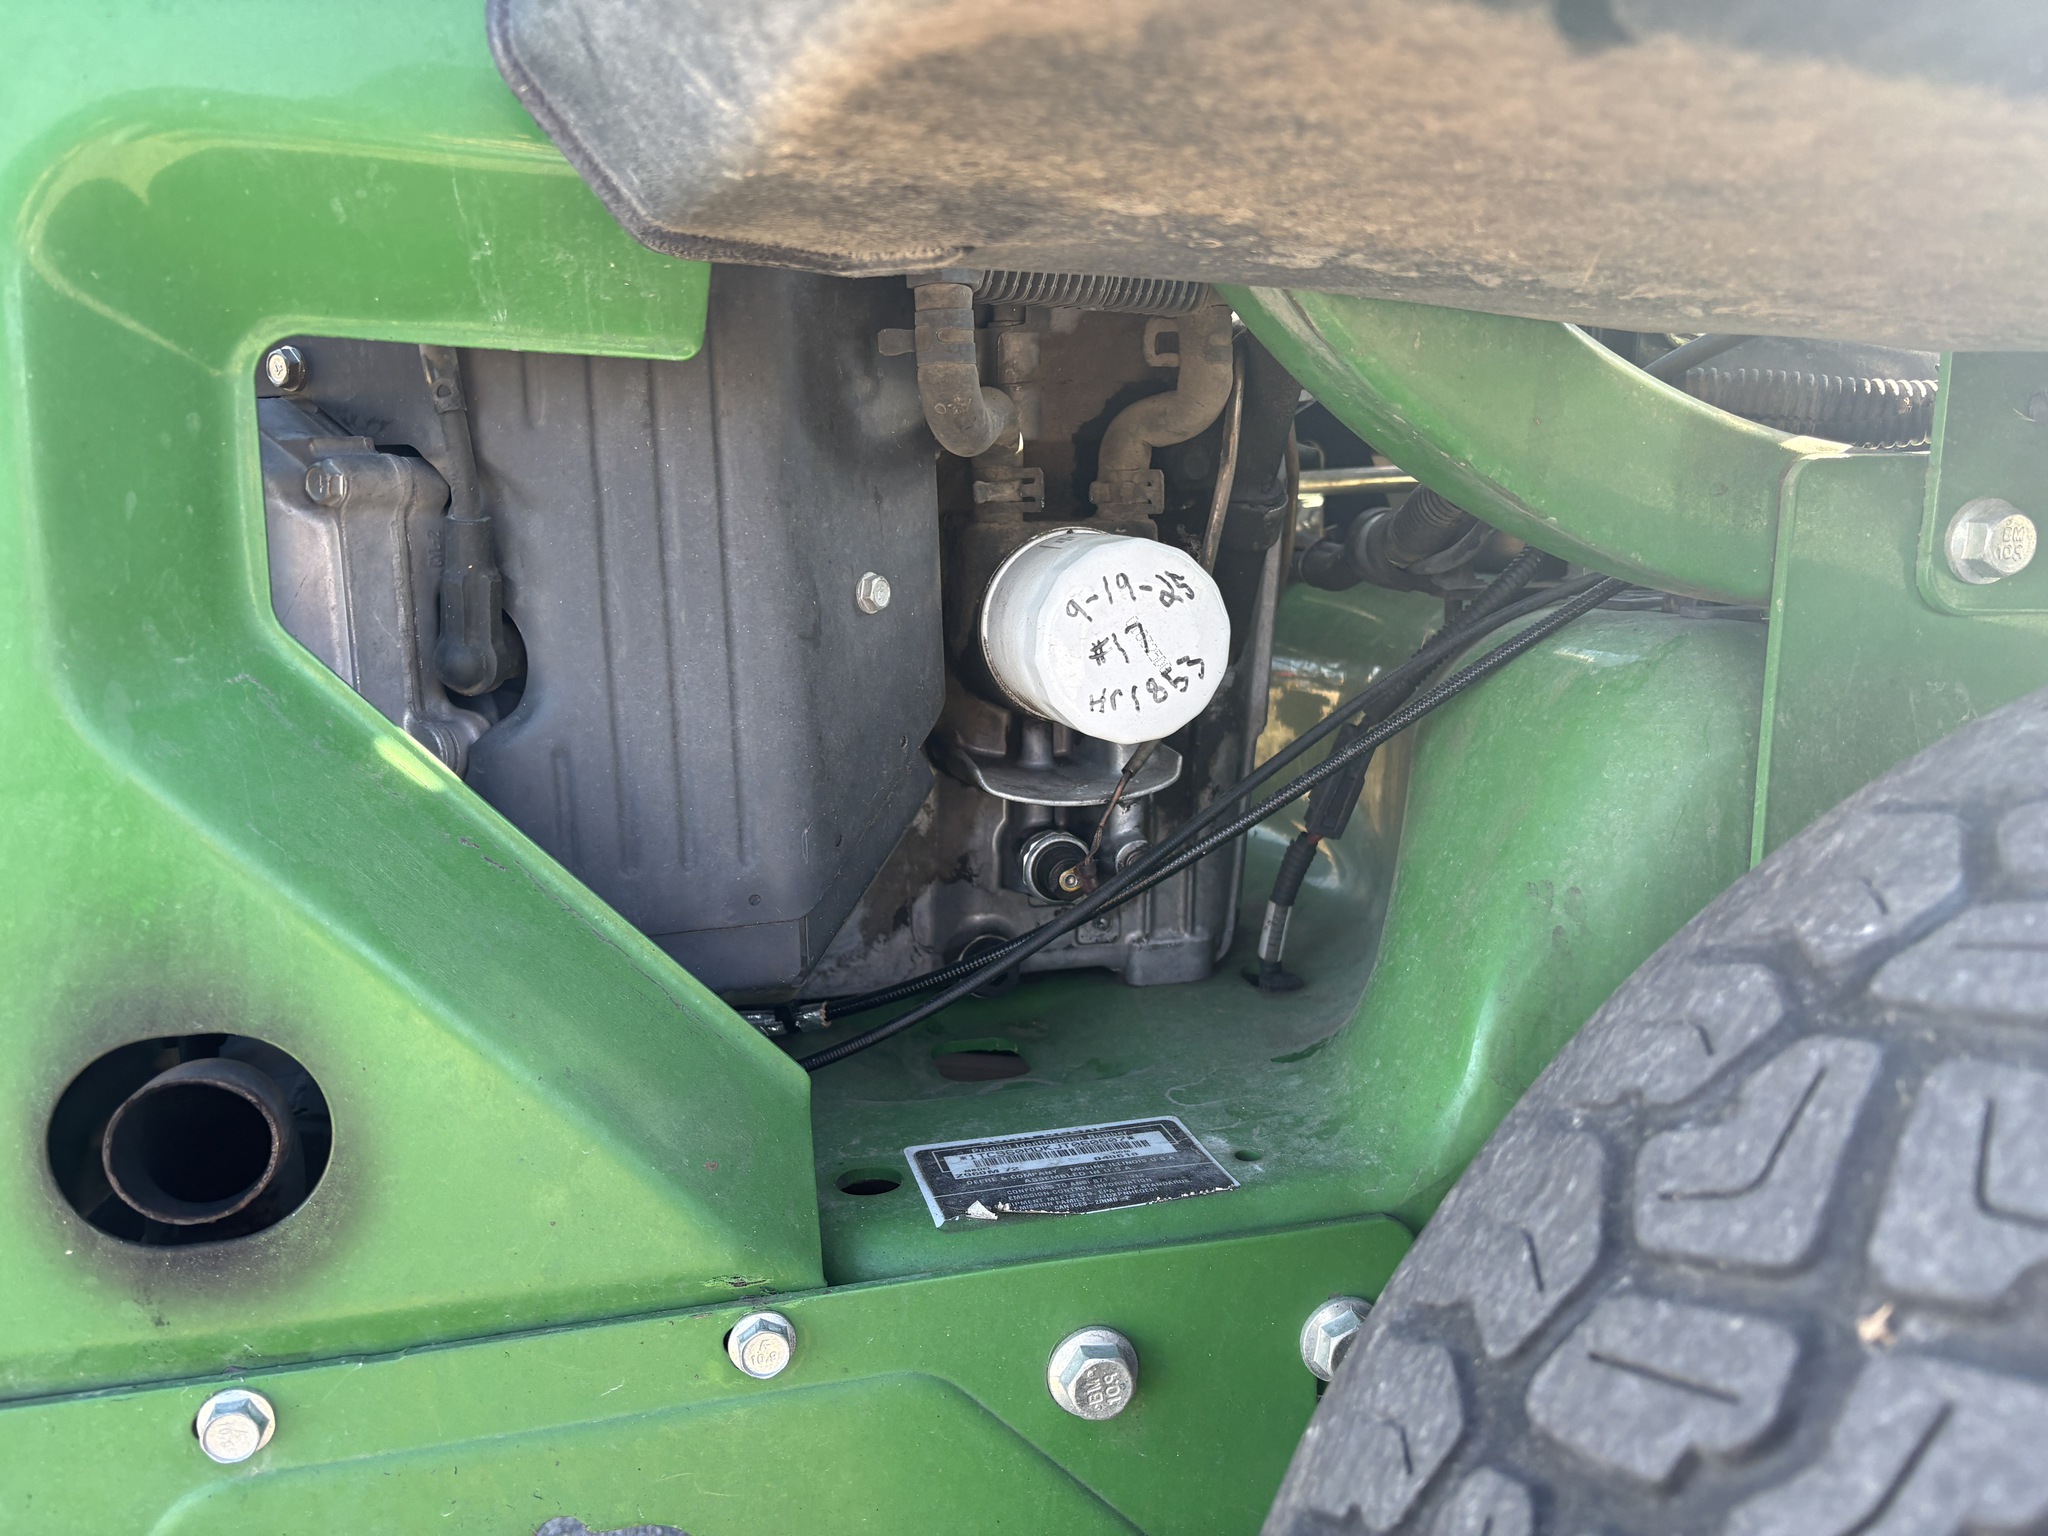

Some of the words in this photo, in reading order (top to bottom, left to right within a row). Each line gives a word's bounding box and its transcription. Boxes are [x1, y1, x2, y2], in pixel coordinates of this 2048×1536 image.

[1066, 571, 1196, 622] 9-19-25
[1089, 622, 1149, 666] #17
[970, 1144, 1012, 1153] Product
[1015, 1136, 1084, 1148] Identification
[1086, 1131, 1128, 1139] Number
[1009, 1170, 1059, 1179] COMPANY
[1024, 1172, 1086, 1183] ASSEMBLED
[1006, 1185, 1055, 1194] CONFORMS
[1008, 1191, 1050, 1200] EMISSION
[1052, 1186, 1093, 1194] CONTROL
[1093, 1178, 1153, 1189] INFORMATION
[1103, 1371, 1122, 1406] 10.9
